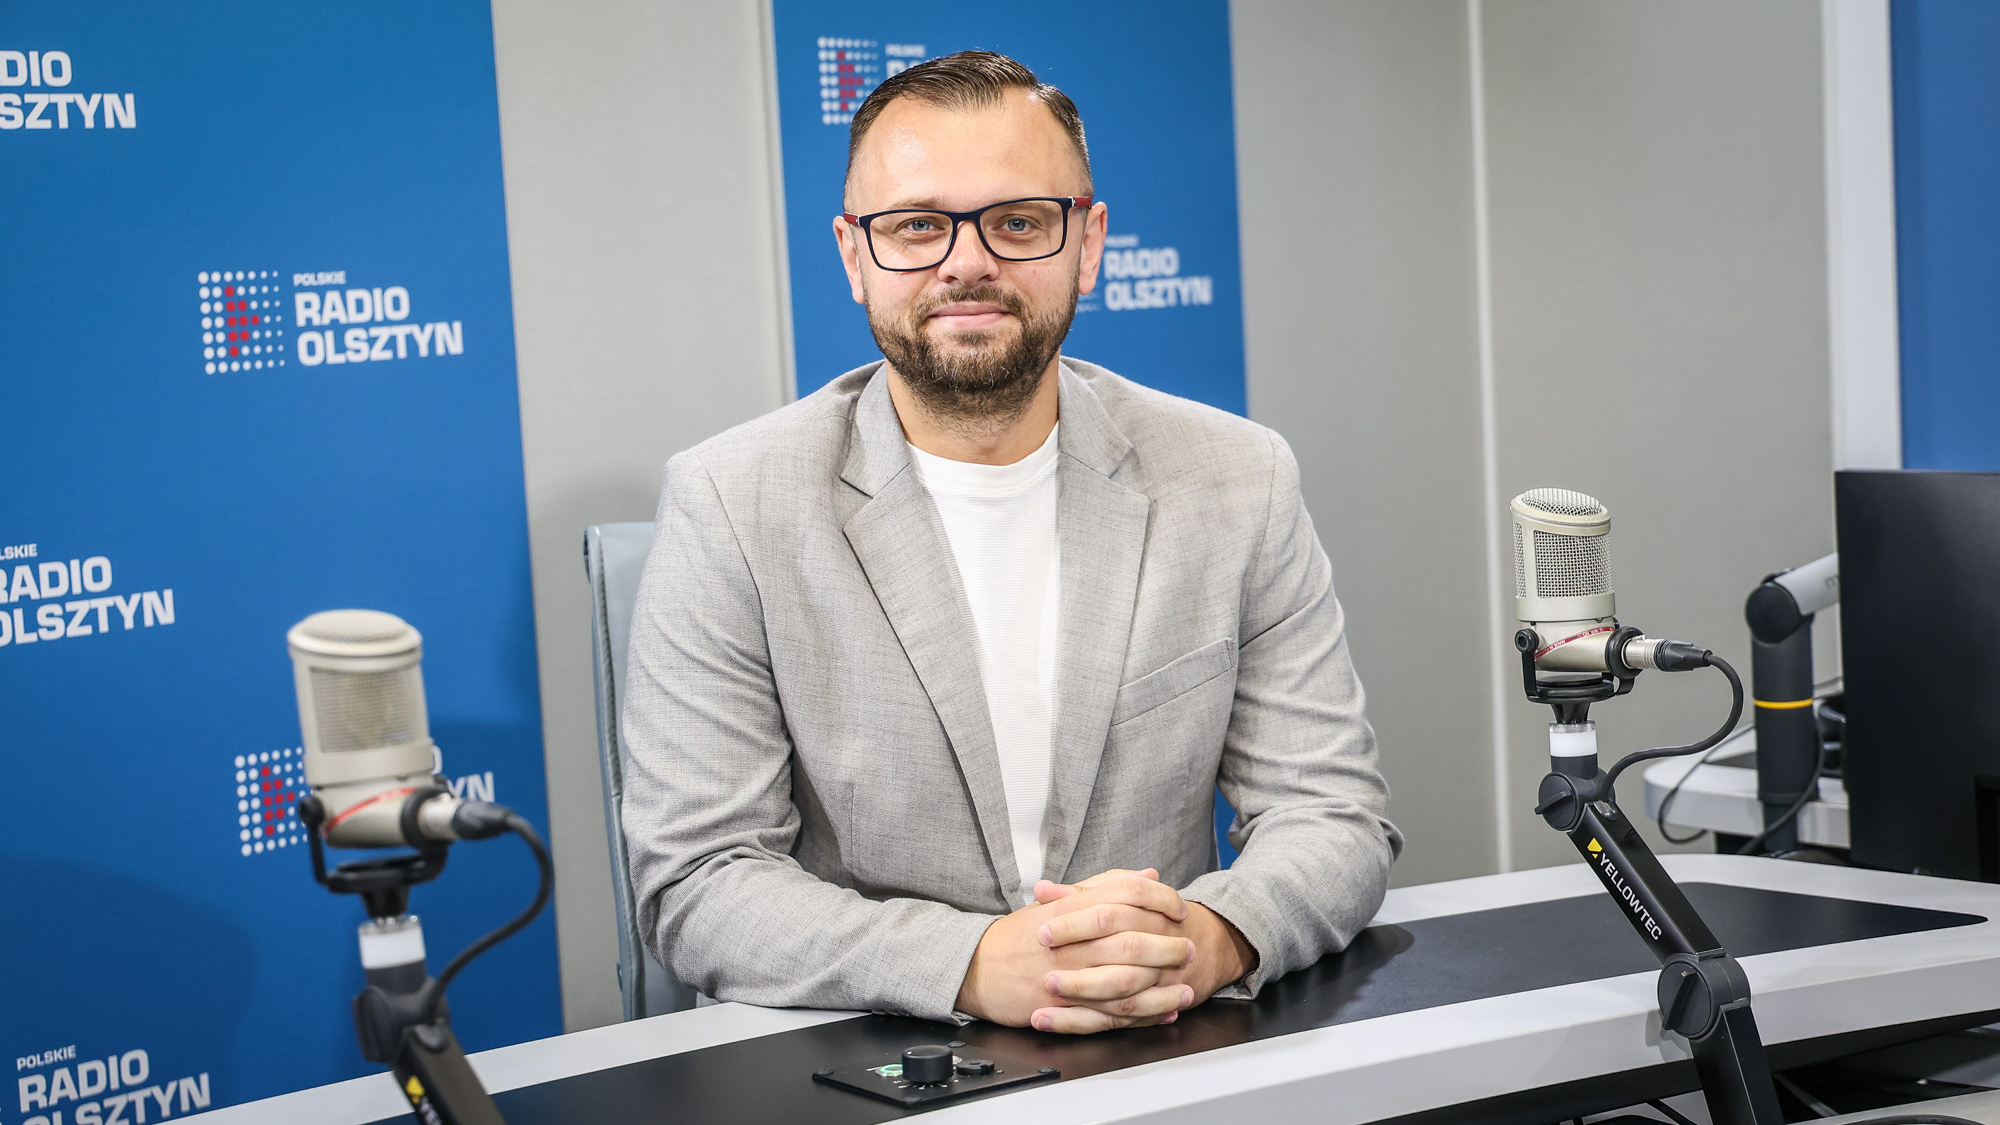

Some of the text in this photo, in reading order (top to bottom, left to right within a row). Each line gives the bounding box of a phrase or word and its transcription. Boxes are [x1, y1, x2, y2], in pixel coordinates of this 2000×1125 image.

[293, 270, 347, 287] POLSKIE
[1103, 246, 1180, 280] RADIO
[294, 286, 411, 327] RADIO
[1104, 275, 1213, 311] OLSZTYN
[297, 320, 465, 367] OLSZTYN
[1600, 853, 1662, 940] YELLOWTEC
[16, 1044, 77, 1071] POLSKIE
[18, 1049, 149, 1113] RADIO
[22, 1072, 211, 1125] SZTYN
